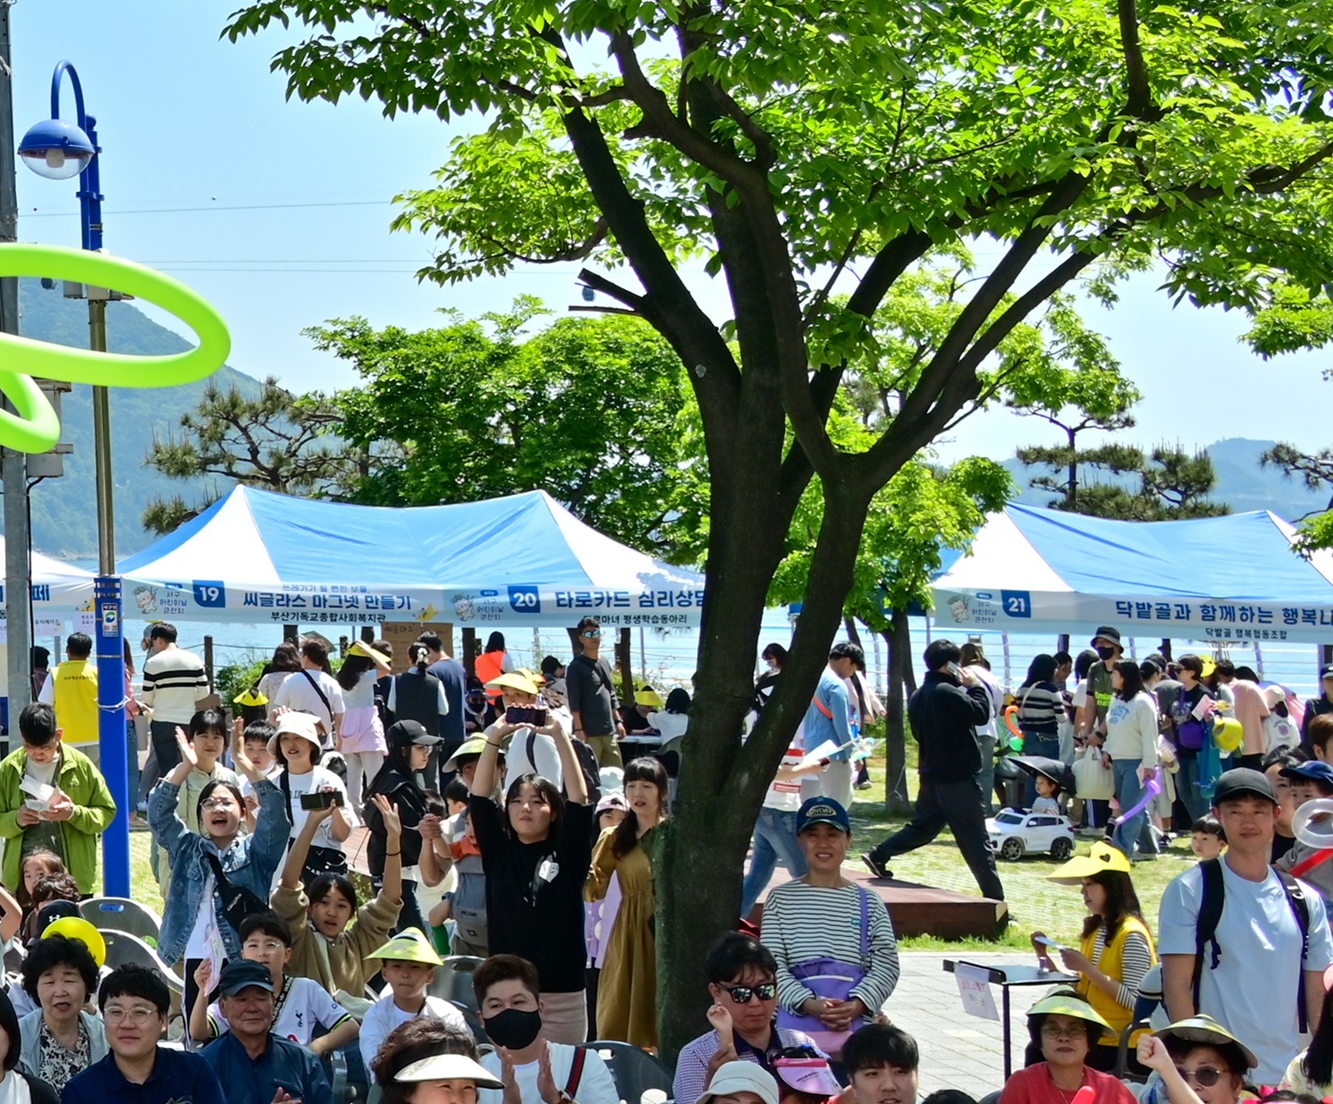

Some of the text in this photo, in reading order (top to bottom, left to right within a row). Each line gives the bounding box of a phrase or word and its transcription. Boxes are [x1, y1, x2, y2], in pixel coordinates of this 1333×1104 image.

[199, 586, 219, 602] 19
[243, 592, 411, 610] 씨글라스 마그넷 만들기
[513, 593, 536, 608] 20
[555, 591, 631, 608] 타로카드
[1008, 597, 1025, 612] 21
[1115, 600, 1191, 621] 닥밭골과
[1199, 604, 1273, 624] 함께하는
[270, 611, 386, 623] 부산기독교종합사회복지관
[624, 614, 688, 625] 평생학습동아리
